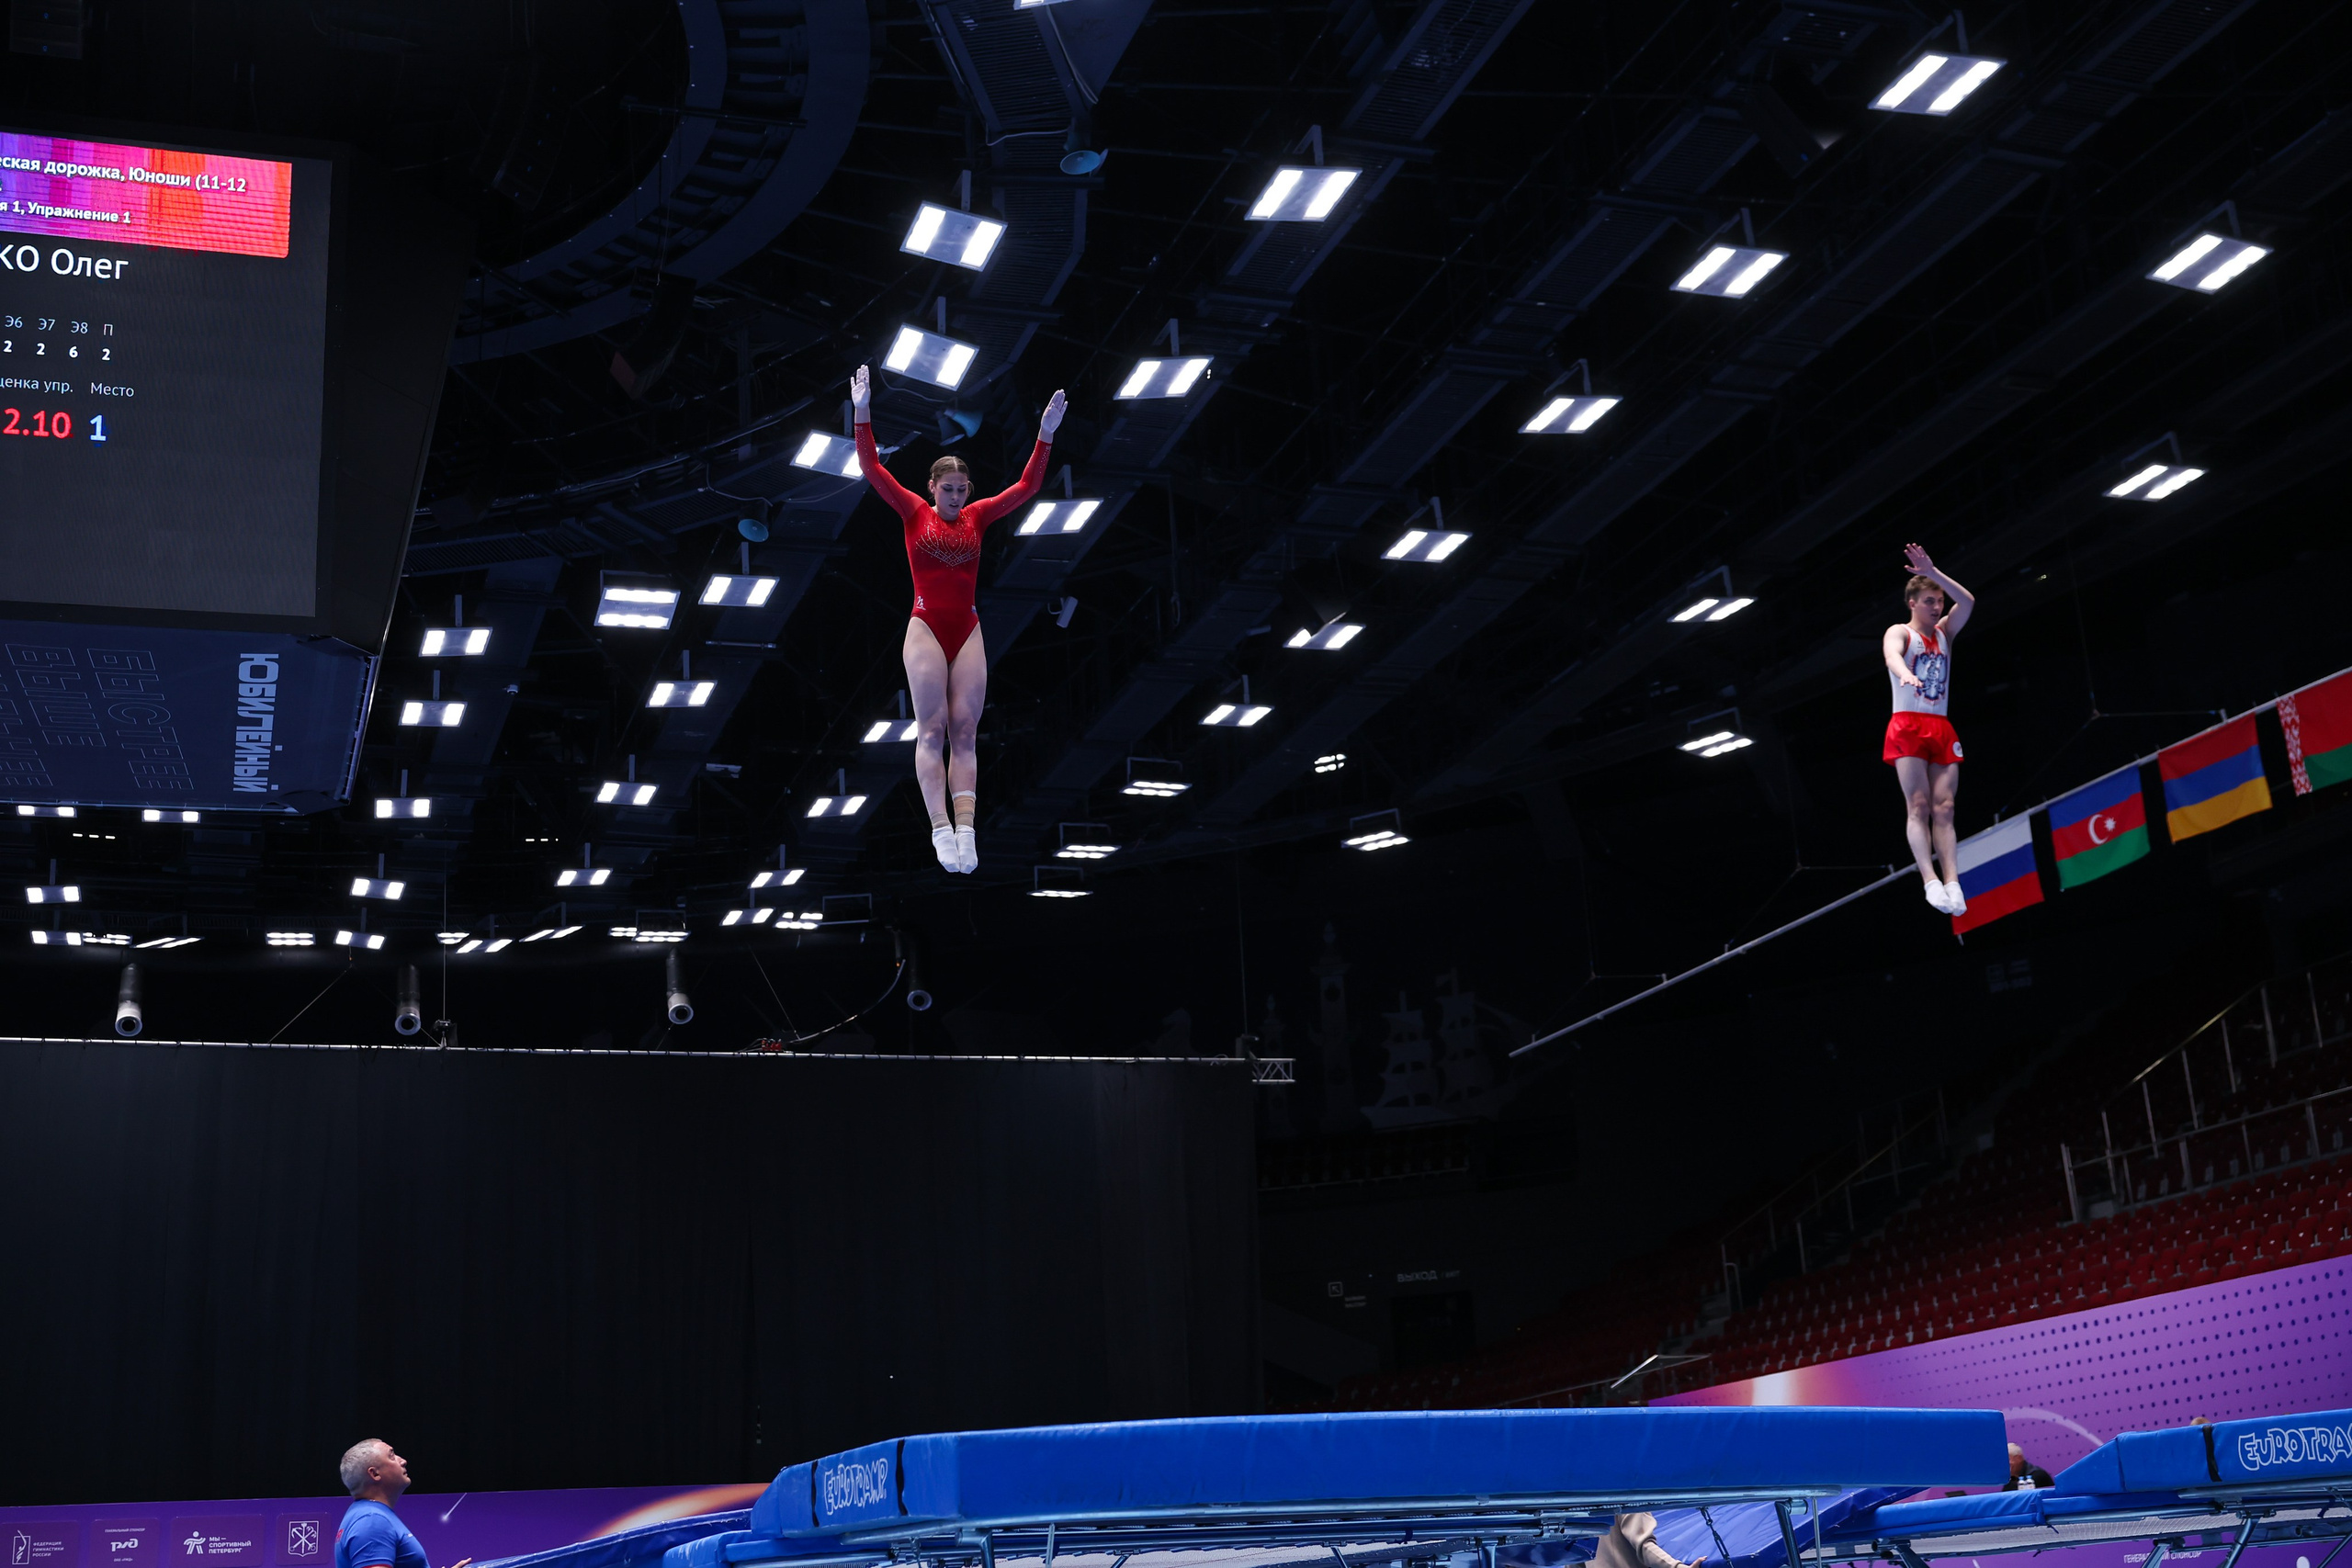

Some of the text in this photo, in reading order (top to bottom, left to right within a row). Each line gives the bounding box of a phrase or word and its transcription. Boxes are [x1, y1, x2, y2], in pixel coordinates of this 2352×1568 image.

[43, 161, 126, 182] дорожка,
[129, 165, 191, 187] Юноши
[195, 174, 247, 194] (11-12
[27, 201, 119, 223] Упражнение
[122, 211, 132, 224] 1
[51, 248, 130, 280] Олег
[5, 315, 113, 336] Э6 Э7 Э8 П
[3, 340, 111, 361] 2 2 6 2
[43, 380, 74, 395] упр.
[90, 382, 135, 398] Место
[2, 407, 73, 439] 2.10
[90, 414, 107, 442] 1
[6, 643, 107, 747] ВЫШЕ
[86, 648, 194, 790] БЫСТРЕЕ
[232, 653, 283, 792] ЮБИЛЕЙНЫЙ
[1396, 1270, 1438, 1282] ВЫХОД
[2238, 1423, 2352, 1471] EUROTRA
[209, 1539, 252, 1548] СПОРТИВНЫЙ
